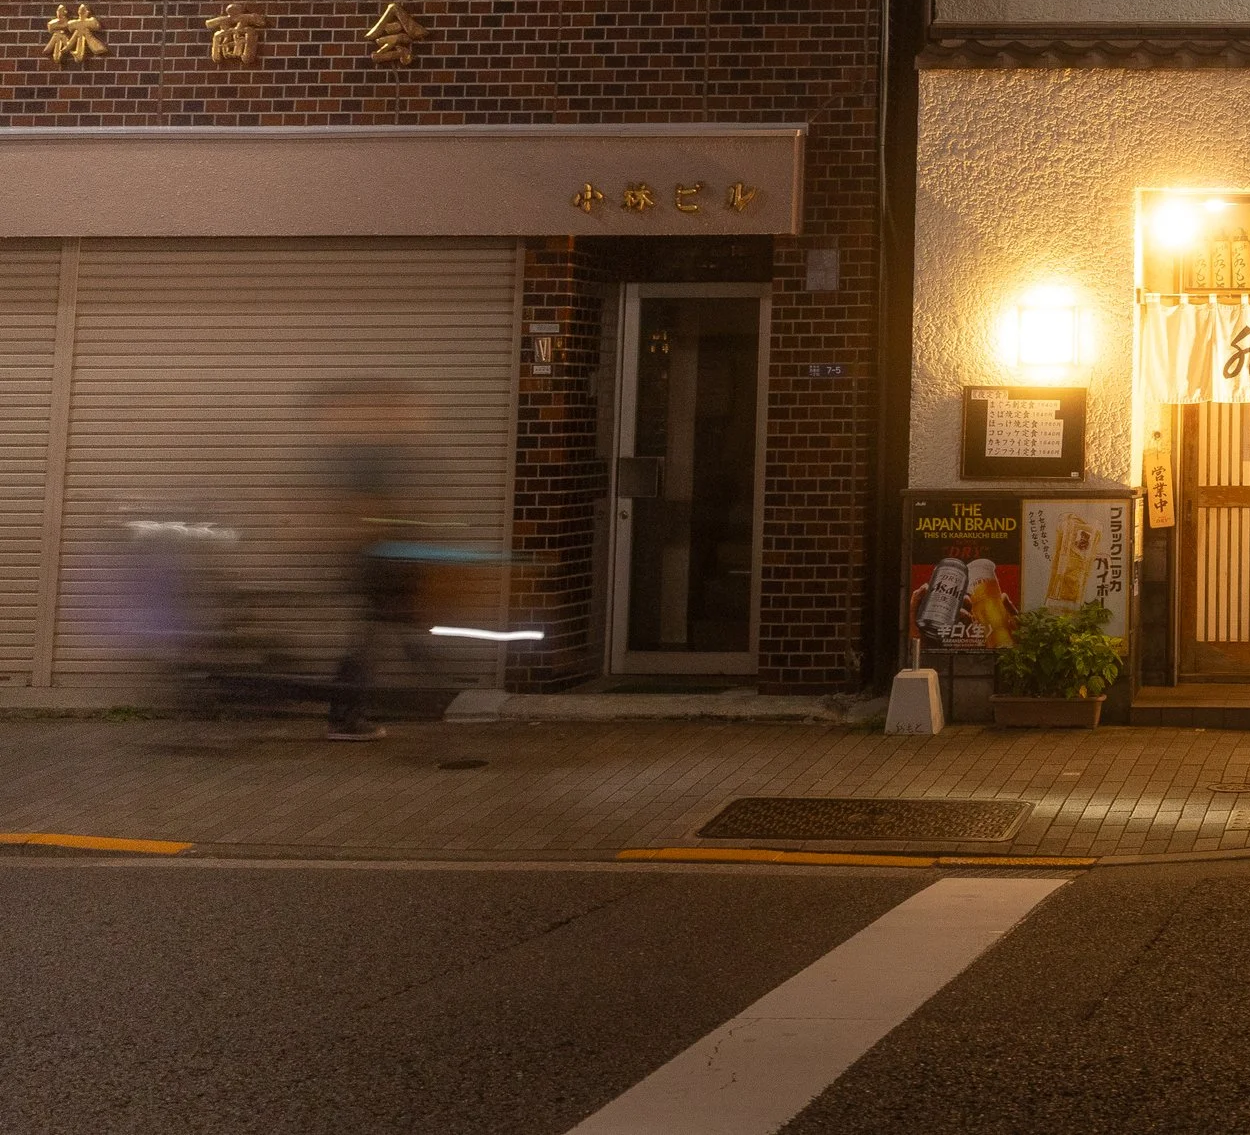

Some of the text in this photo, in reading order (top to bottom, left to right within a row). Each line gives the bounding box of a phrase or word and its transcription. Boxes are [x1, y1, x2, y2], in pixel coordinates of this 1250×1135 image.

[43, 3, 431, 66] 林商会
[572, 181, 758, 215] 小林ビル
[827, 366, 841, 375] 7-5
[988, 429, 1039, 438] コロッケ定食
[987, 438, 1038, 447] カキフライ定食
[986, 447, 1037, 456] アジフライ定食
[1151, 465, 1169, 513] 営業中
[952, 503, 982, 517] THE
[915, 517, 1017, 532] JAPAN BRAND
[1109, 506, 1124, 593] ブラックニッカ
